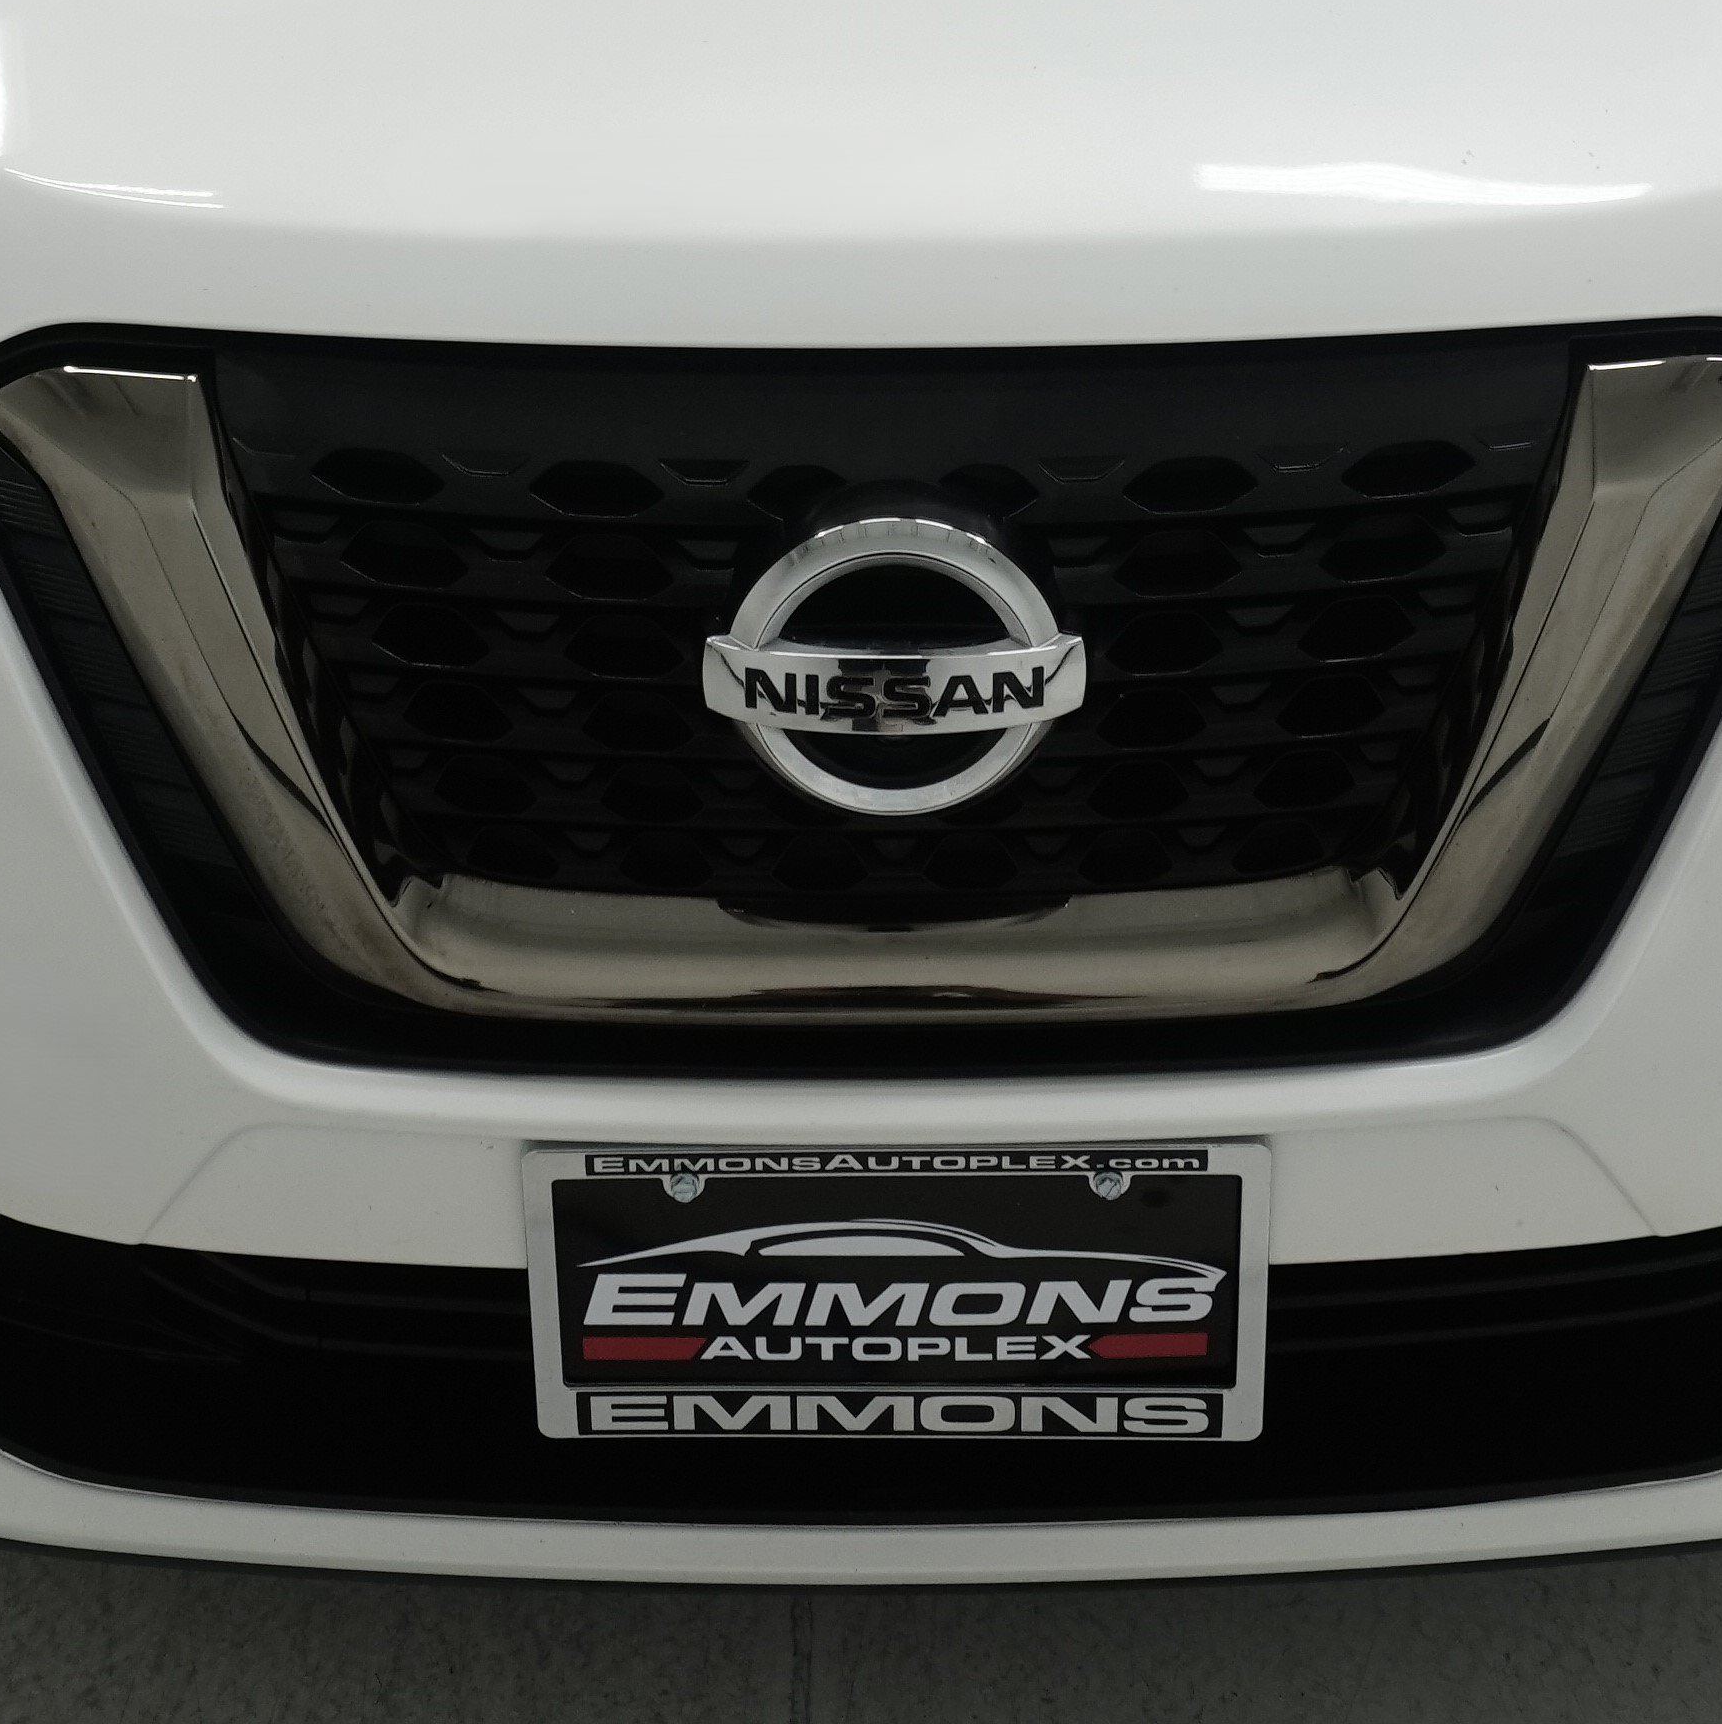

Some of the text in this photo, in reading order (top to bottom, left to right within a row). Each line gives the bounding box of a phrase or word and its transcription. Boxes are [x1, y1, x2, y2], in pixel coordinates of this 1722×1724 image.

[744, 666, 1045, 719] NISSAN
[583, 1272, 1218, 1327] EMMONS
[700, 1335, 1092, 1362] AUTOPLEX
[590, 1394, 1209, 1434] EMMONS
